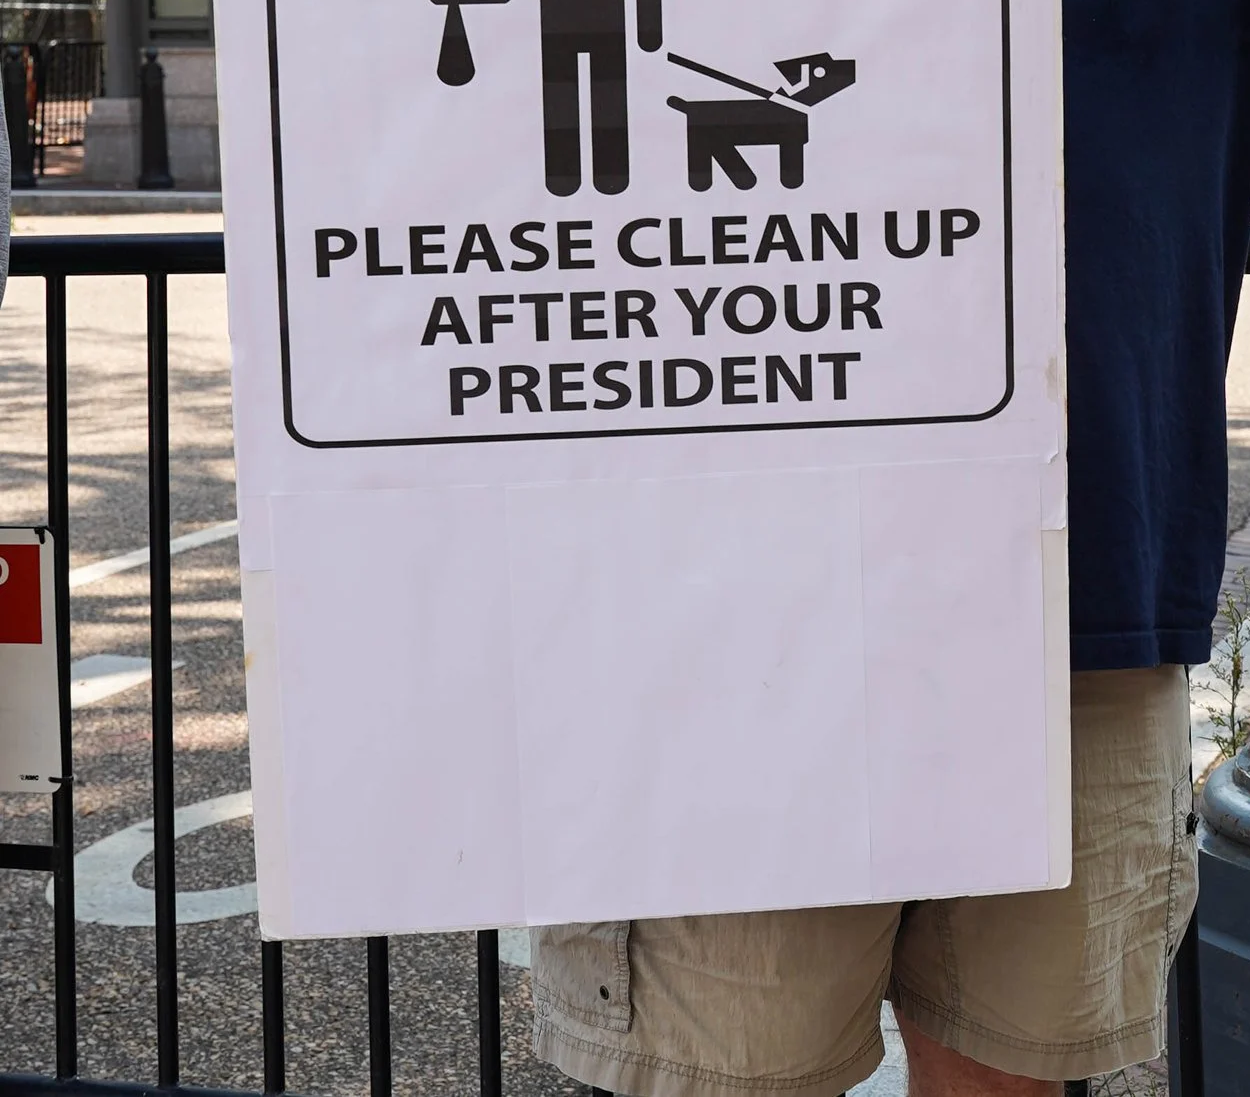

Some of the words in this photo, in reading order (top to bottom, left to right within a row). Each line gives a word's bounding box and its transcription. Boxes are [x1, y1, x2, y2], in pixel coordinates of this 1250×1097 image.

[315, 221, 594, 277] PLEASE
[618, 213, 858, 267] CLEAN
[885, 209, 980, 258] UP
[421, 290, 658, 345] AFTER
[674, 282, 882, 335] YOUR
[450, 352, 861, 416] PRESIDENT
